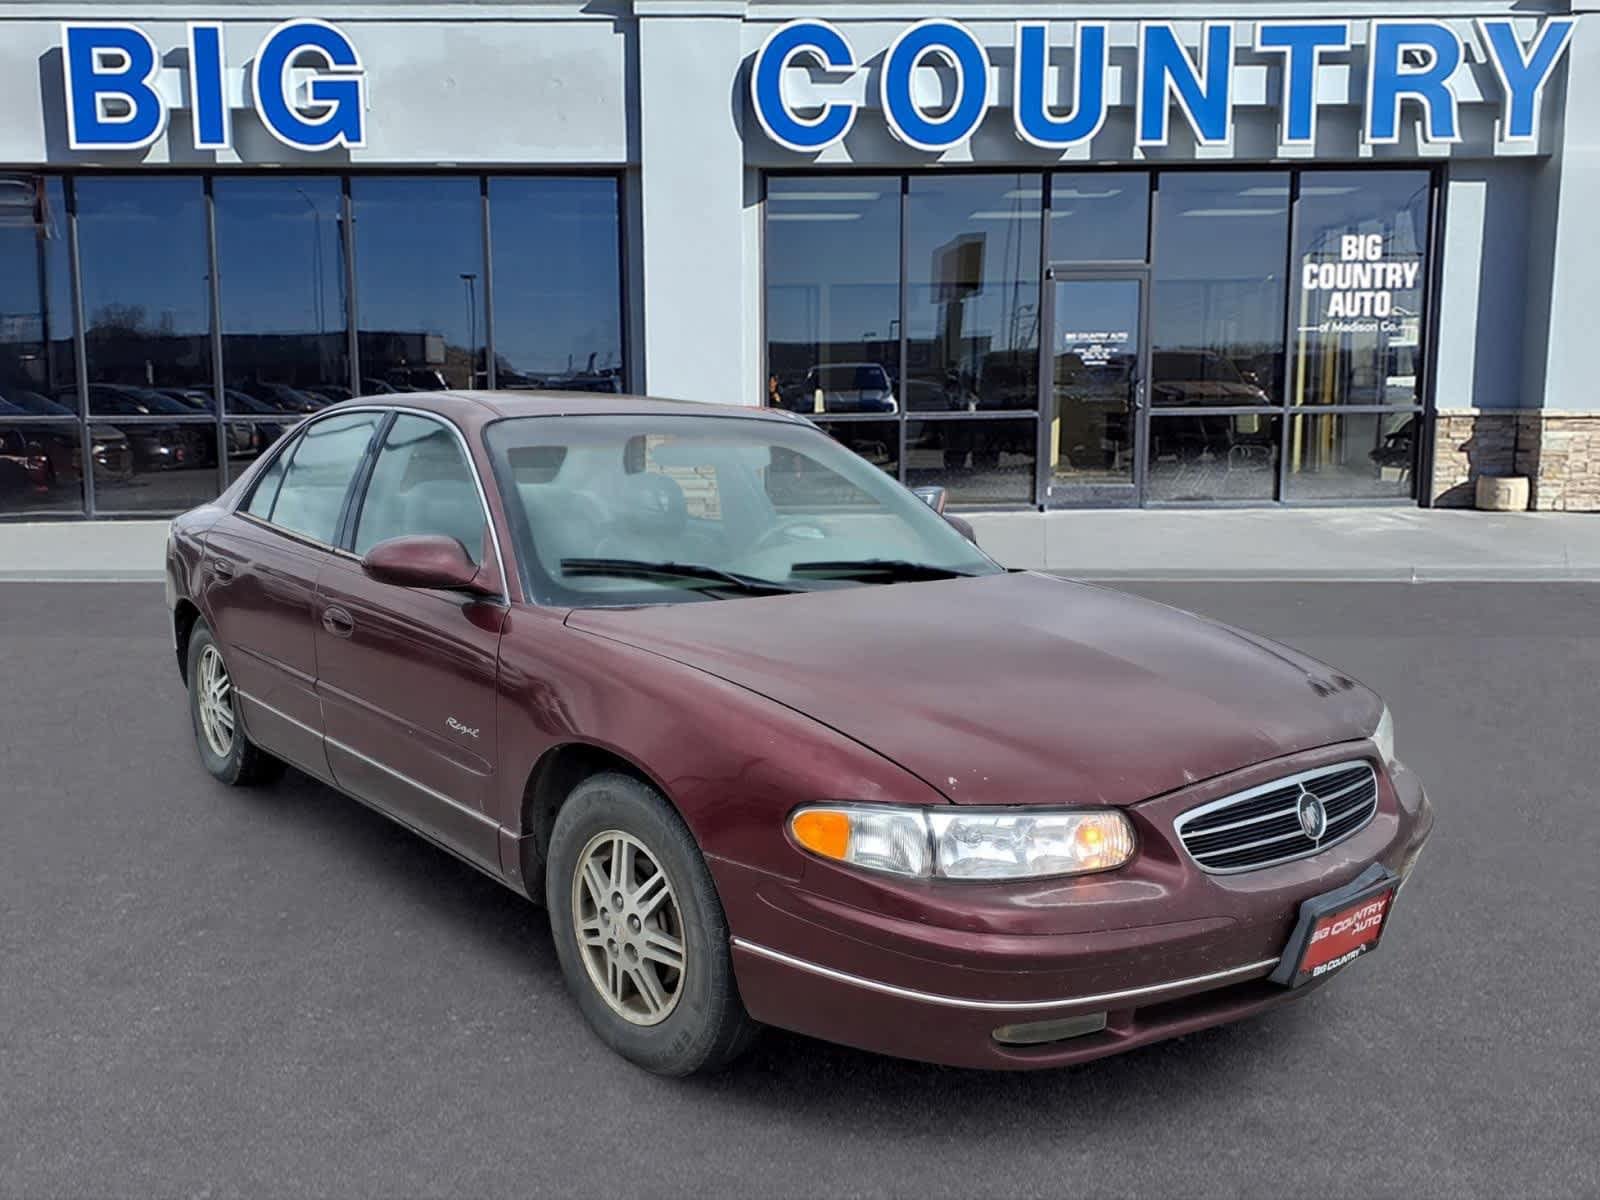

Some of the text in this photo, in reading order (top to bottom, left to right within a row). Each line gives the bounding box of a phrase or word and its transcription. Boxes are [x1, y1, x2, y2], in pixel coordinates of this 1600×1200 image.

[61, 18, 1576, 154] BIG COUNTRY
[1341, 234, 1382, 261] BIG
[1302, 262, 1419, 289] COUNTRY
[1328, 291, 1391, 317] AUTO
[1319, 321, 1399, 333] of Madison Co.
[1310, 900, 1386, 944] BIG COUNTRY
[1352, 914, 1382, 936] AUTO
[1327, 949, 1361, 971] COUNTRY
